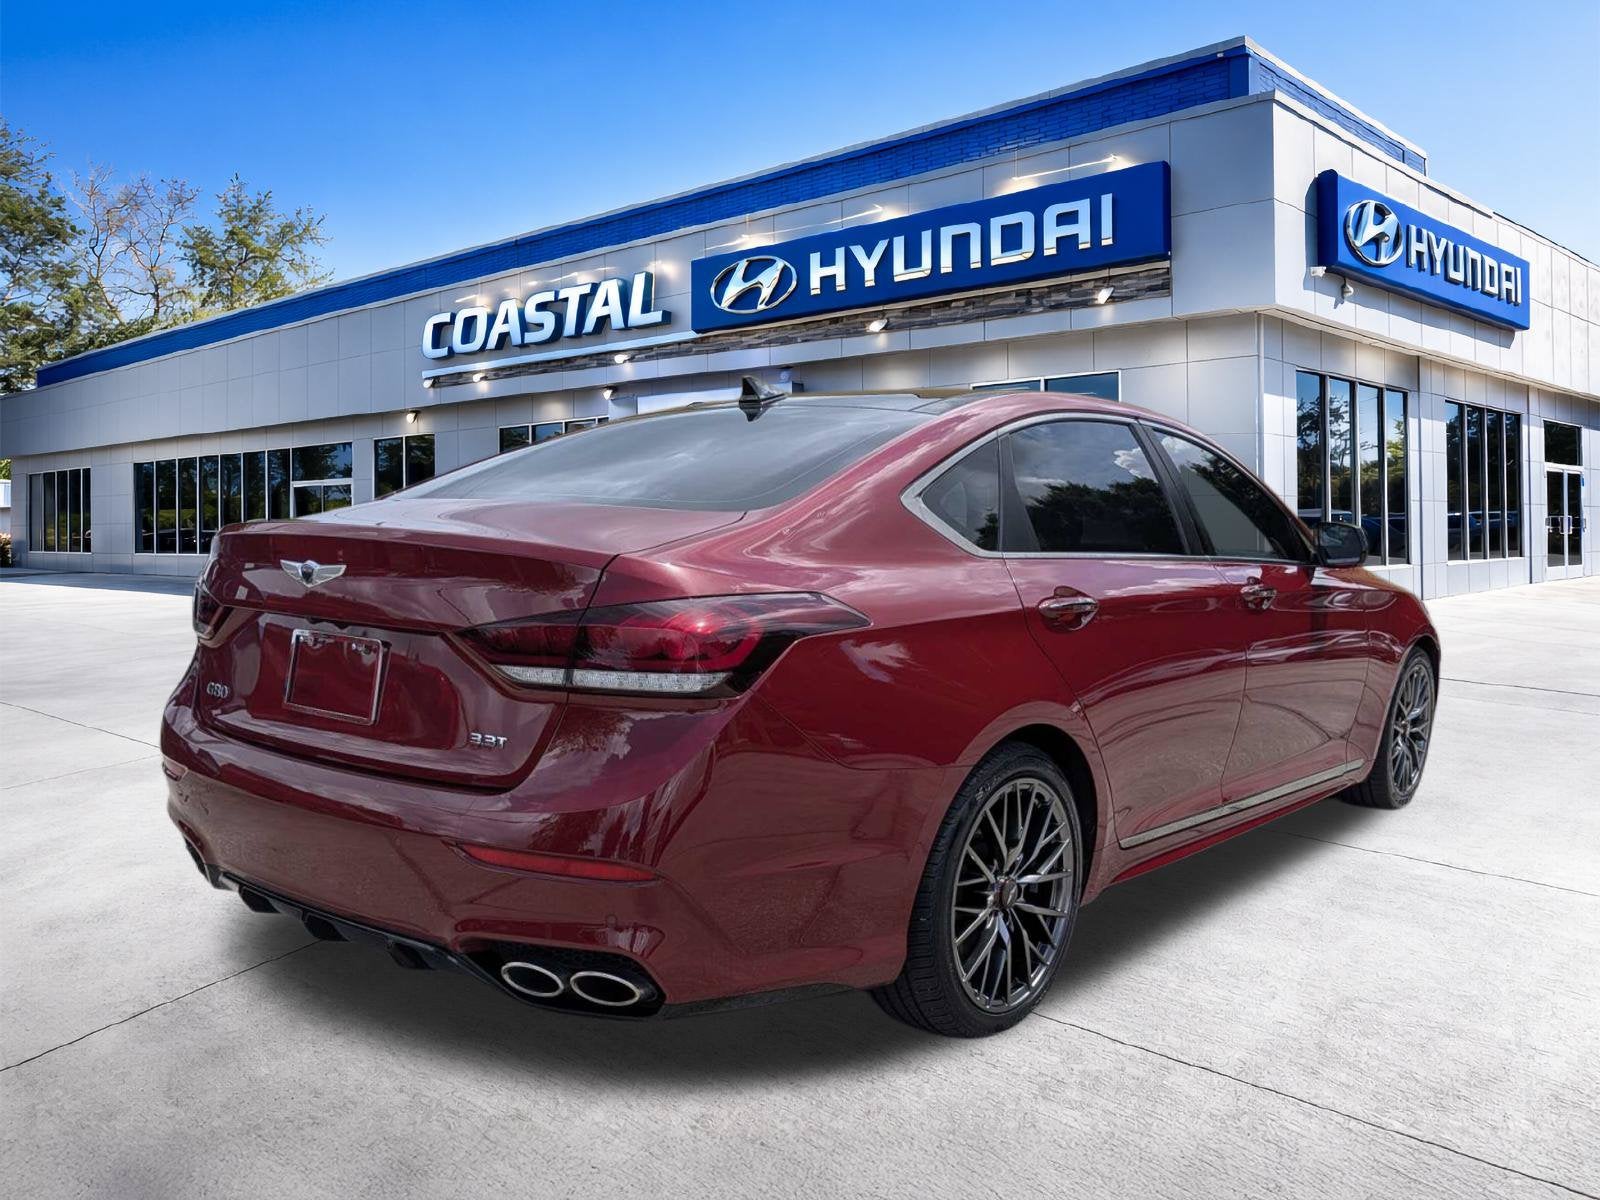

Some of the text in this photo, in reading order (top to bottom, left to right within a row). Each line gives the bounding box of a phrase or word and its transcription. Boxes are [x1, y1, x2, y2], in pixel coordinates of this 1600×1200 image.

[809, 192, 1114, 296] HYUNDAI
[1406, 223, 1522, 306] HYUNDAI
[421, 271, 669, 360] COASTAL
